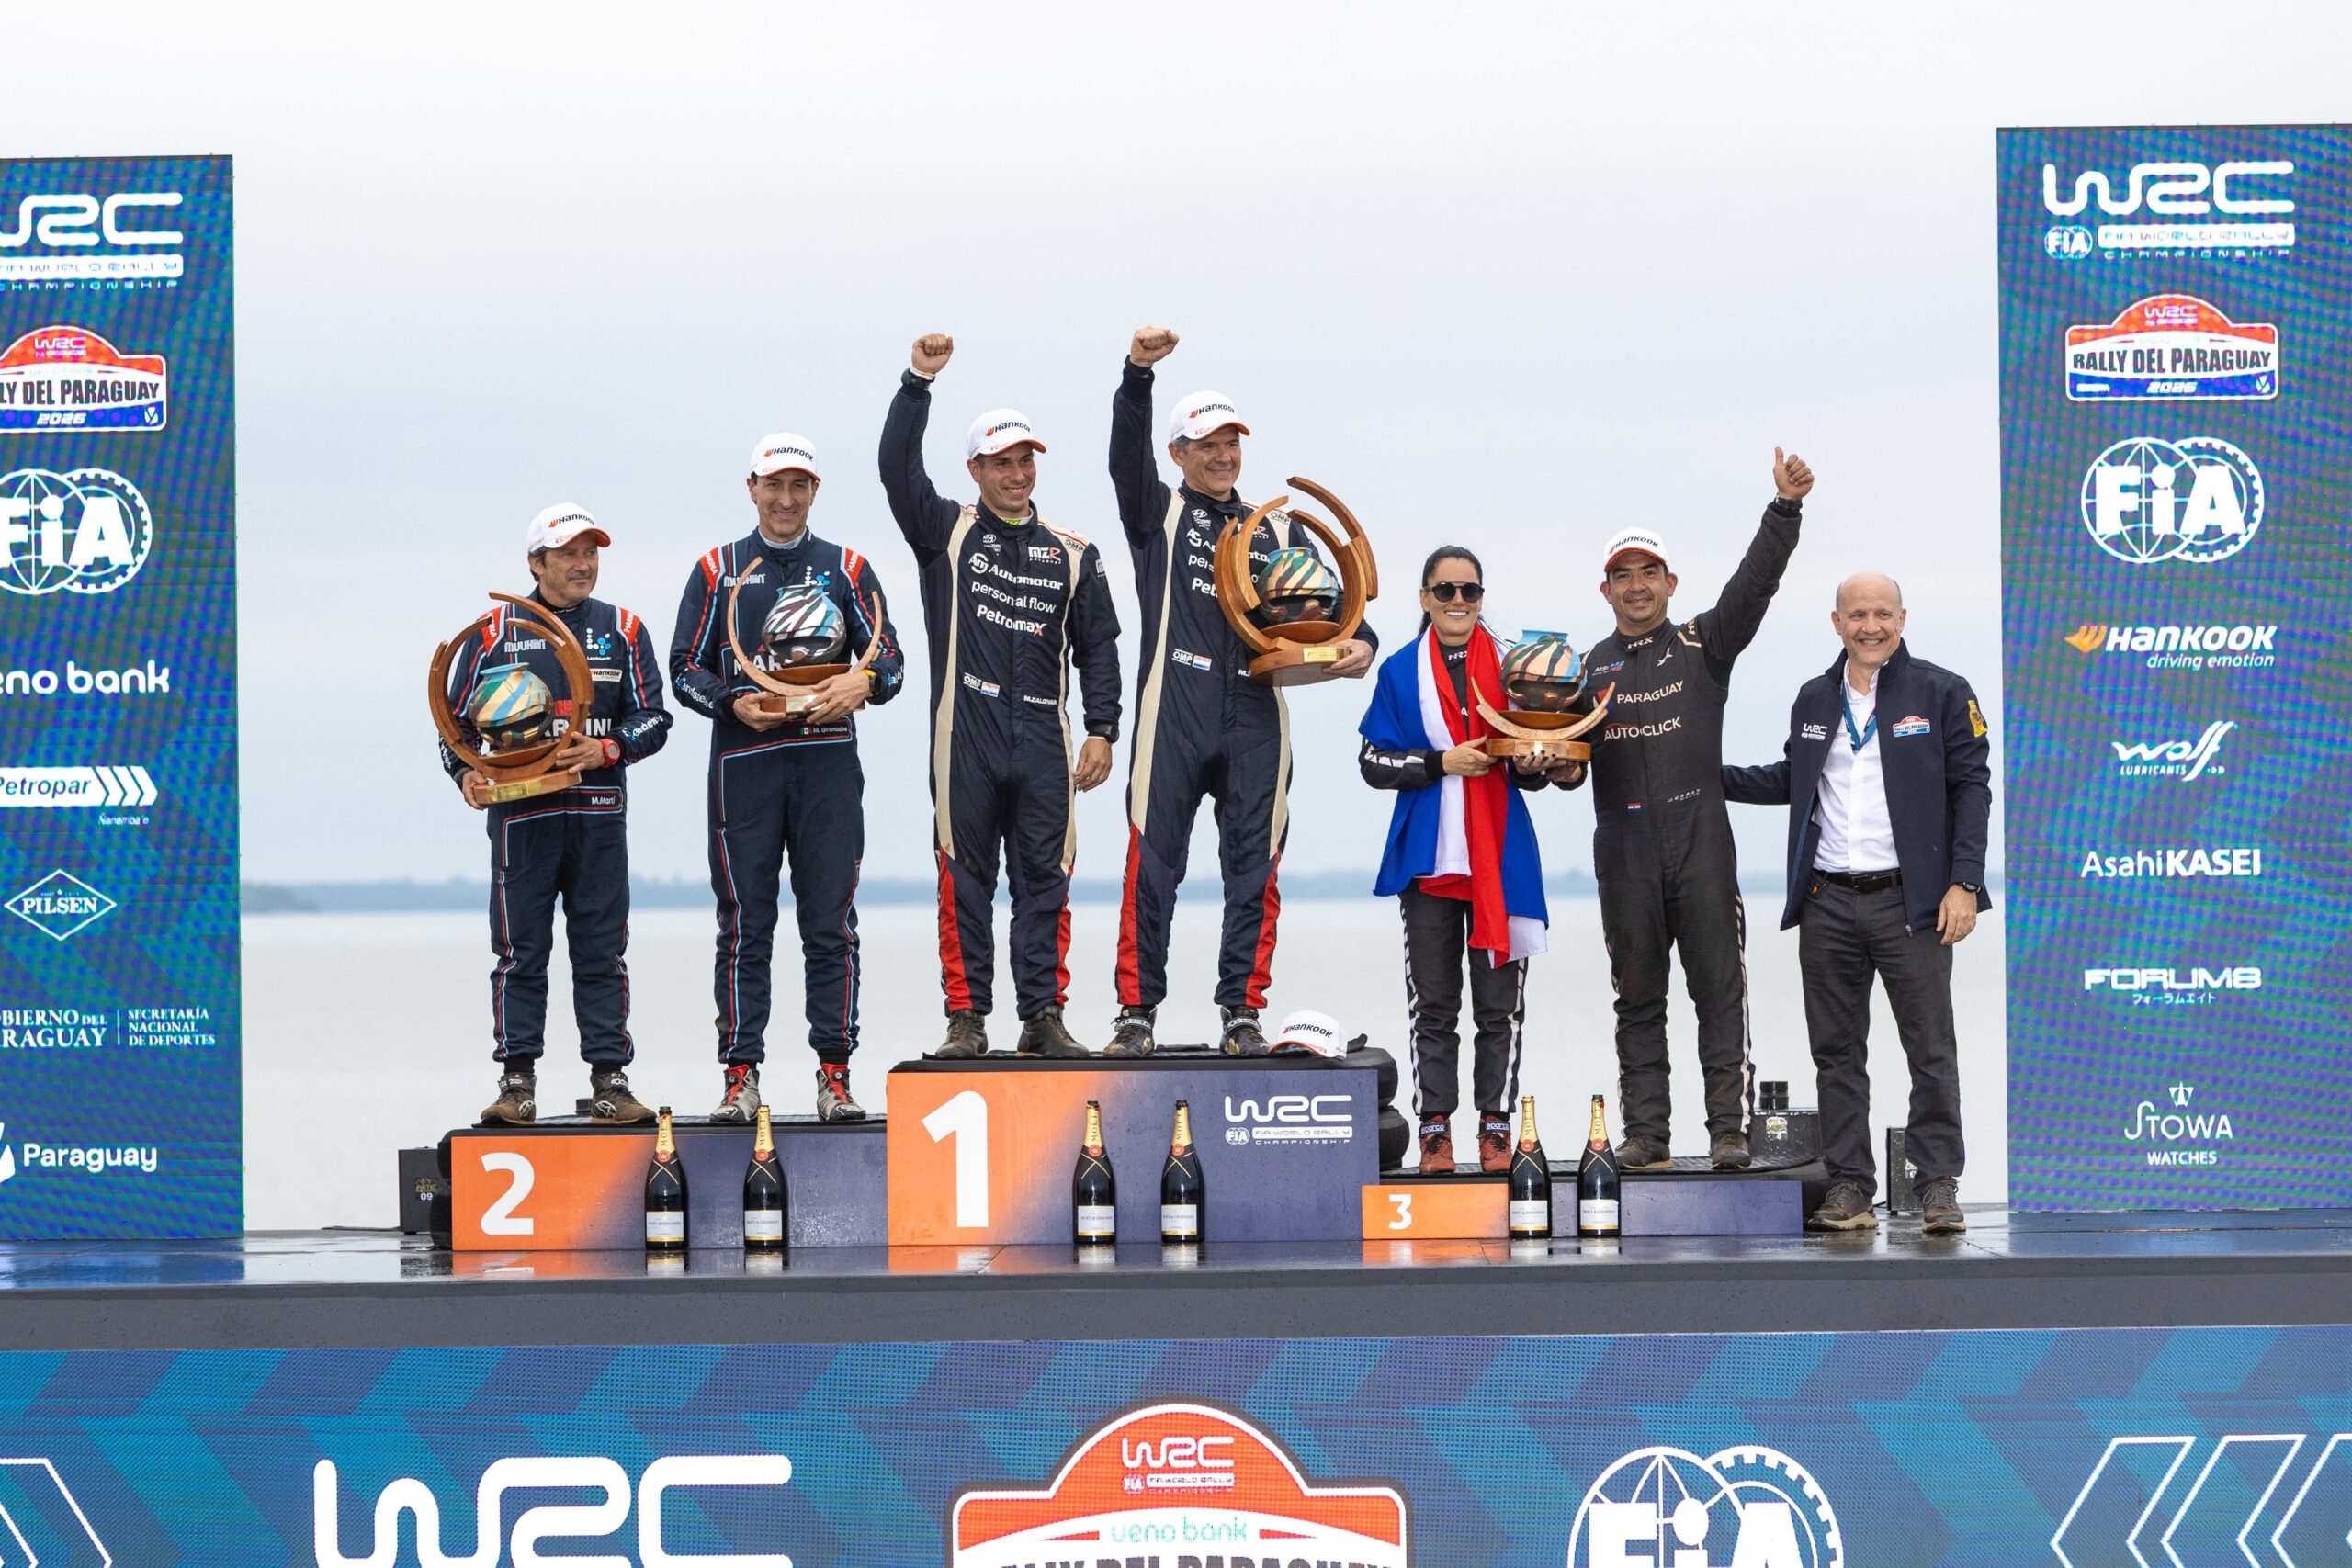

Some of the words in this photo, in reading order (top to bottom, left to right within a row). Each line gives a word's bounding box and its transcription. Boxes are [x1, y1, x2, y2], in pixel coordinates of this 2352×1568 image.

[2043, 161, 2295, 215] WRC
[2144, 305, 2198, 319] WRC
[2073, 350, 2128, 372] RALLY
[2132, 348, 2165, 373] DEL
[2171, 348, 2271, 373] PARAGUAY
[23, 380, 54, 405] DEL
[61, 379, 159, 405] PARAGUAY
[2146, 381, 2198, 393] 2026
[37, 412, 86, 425] 2026
[989, 564, 1063, 590] Automotor
[971, 581, 1027, 608] personal
[1029, 597, 1056, 614] flow
[1627, 637, 1654, 649] HRX
[1172, 650, 1193, 663] OMP
[2146, 653, 2202, 670] driving
[2207, 652, 2274, 667] emotion
[0, 670, 58, 694] no
[67, 660, 169, 694] bank
[1617, 681, 1683, 704] PARAGUAY
[1804, 723, 1828, 735] WRC
[2120, 765, 2187, 776] LUBRICANTS
[22, 897, 98, 914] PILSEN
[2084, 967, 2262, 990] FORUM8
[2132, 992, 2216, 1005] フォーラムエイト
[0, 1010, 79, 1026] BIERNO
[82, 1014, 107, 1025] DEL
[128, 1006, 209, 1020] SECRETARÍA
[129, 1021, 198, 1032] NACIONAL
[0, 1028, 107, 1048] RAGUAY
[129, 1034, 146, 1046] DE
[149, 1034, 215, 1046] DEPORTES
[1225, 1095, 1352, 1122] WRC
[24, 1143, 157, 1173] Paraguay
[922, 1090, 989, 1228] 1
[2147, 1151, 2217, 1166] WATCHES
[481, 1152, 535, 1236] 2
[1388, 1194, 1412, 1230] 3
[1122, 1436, 1235, 1469] WRC
[313, 1455, 793, 1568] WRC
[1111, 1523, 1176, 1543] ueno
[1183, 1516, 1248, 1543] bank
